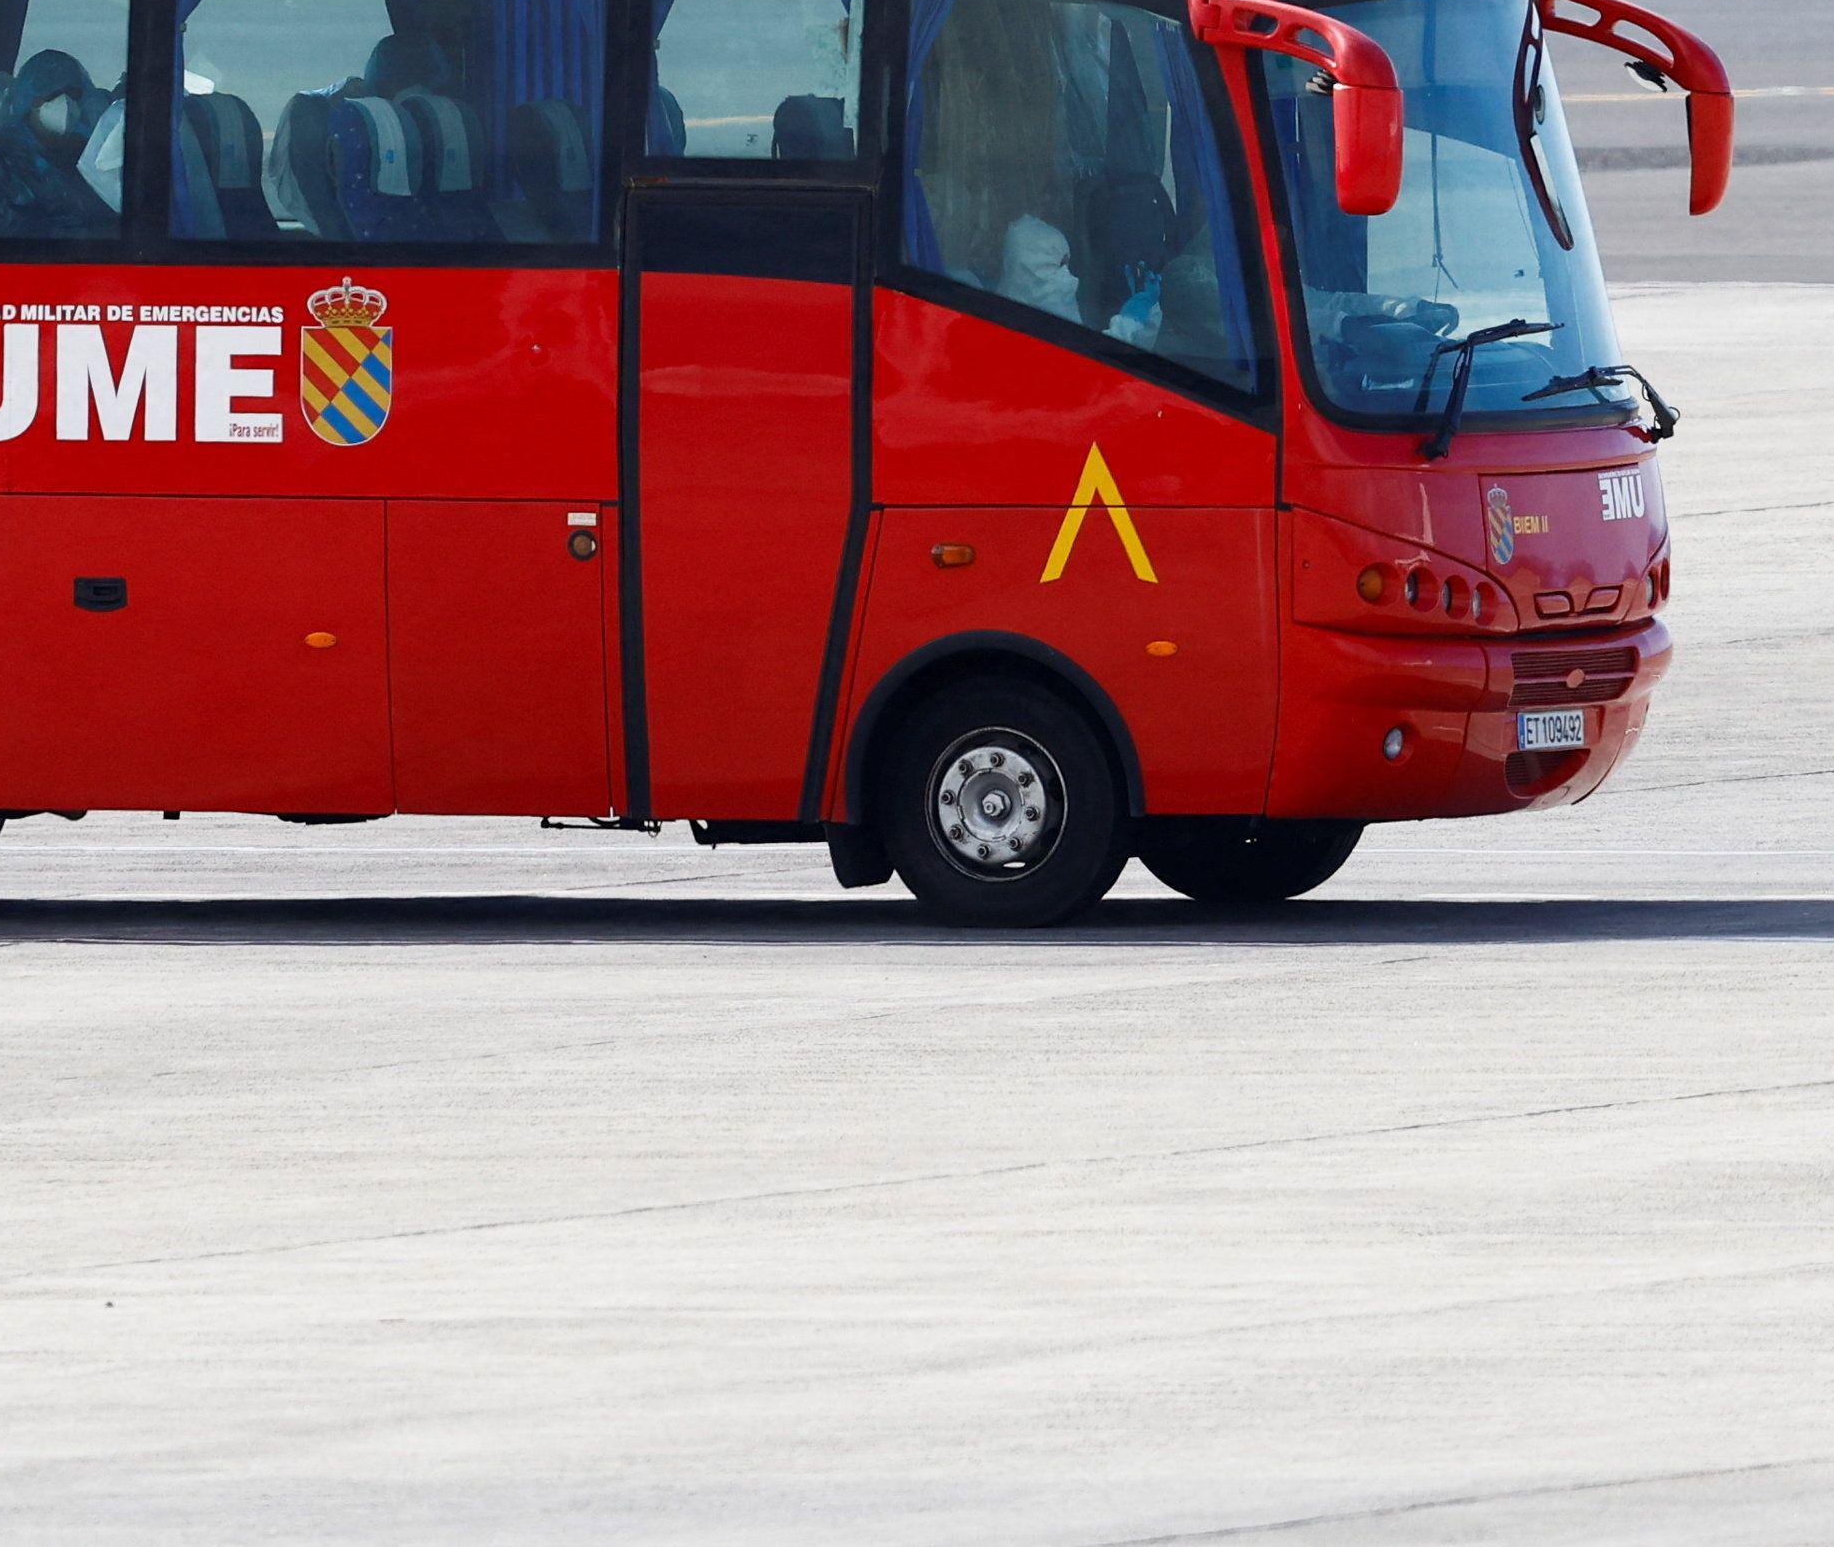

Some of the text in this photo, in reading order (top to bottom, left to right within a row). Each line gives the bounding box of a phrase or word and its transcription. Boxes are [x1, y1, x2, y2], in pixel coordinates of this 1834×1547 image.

[20, 304, 101, 322] MILITAR
[106, 305, 134, 322] DE
[139, 306, 284, 323] EMERGENCIAS
[1513, 515, 1540, 534] BIEM
